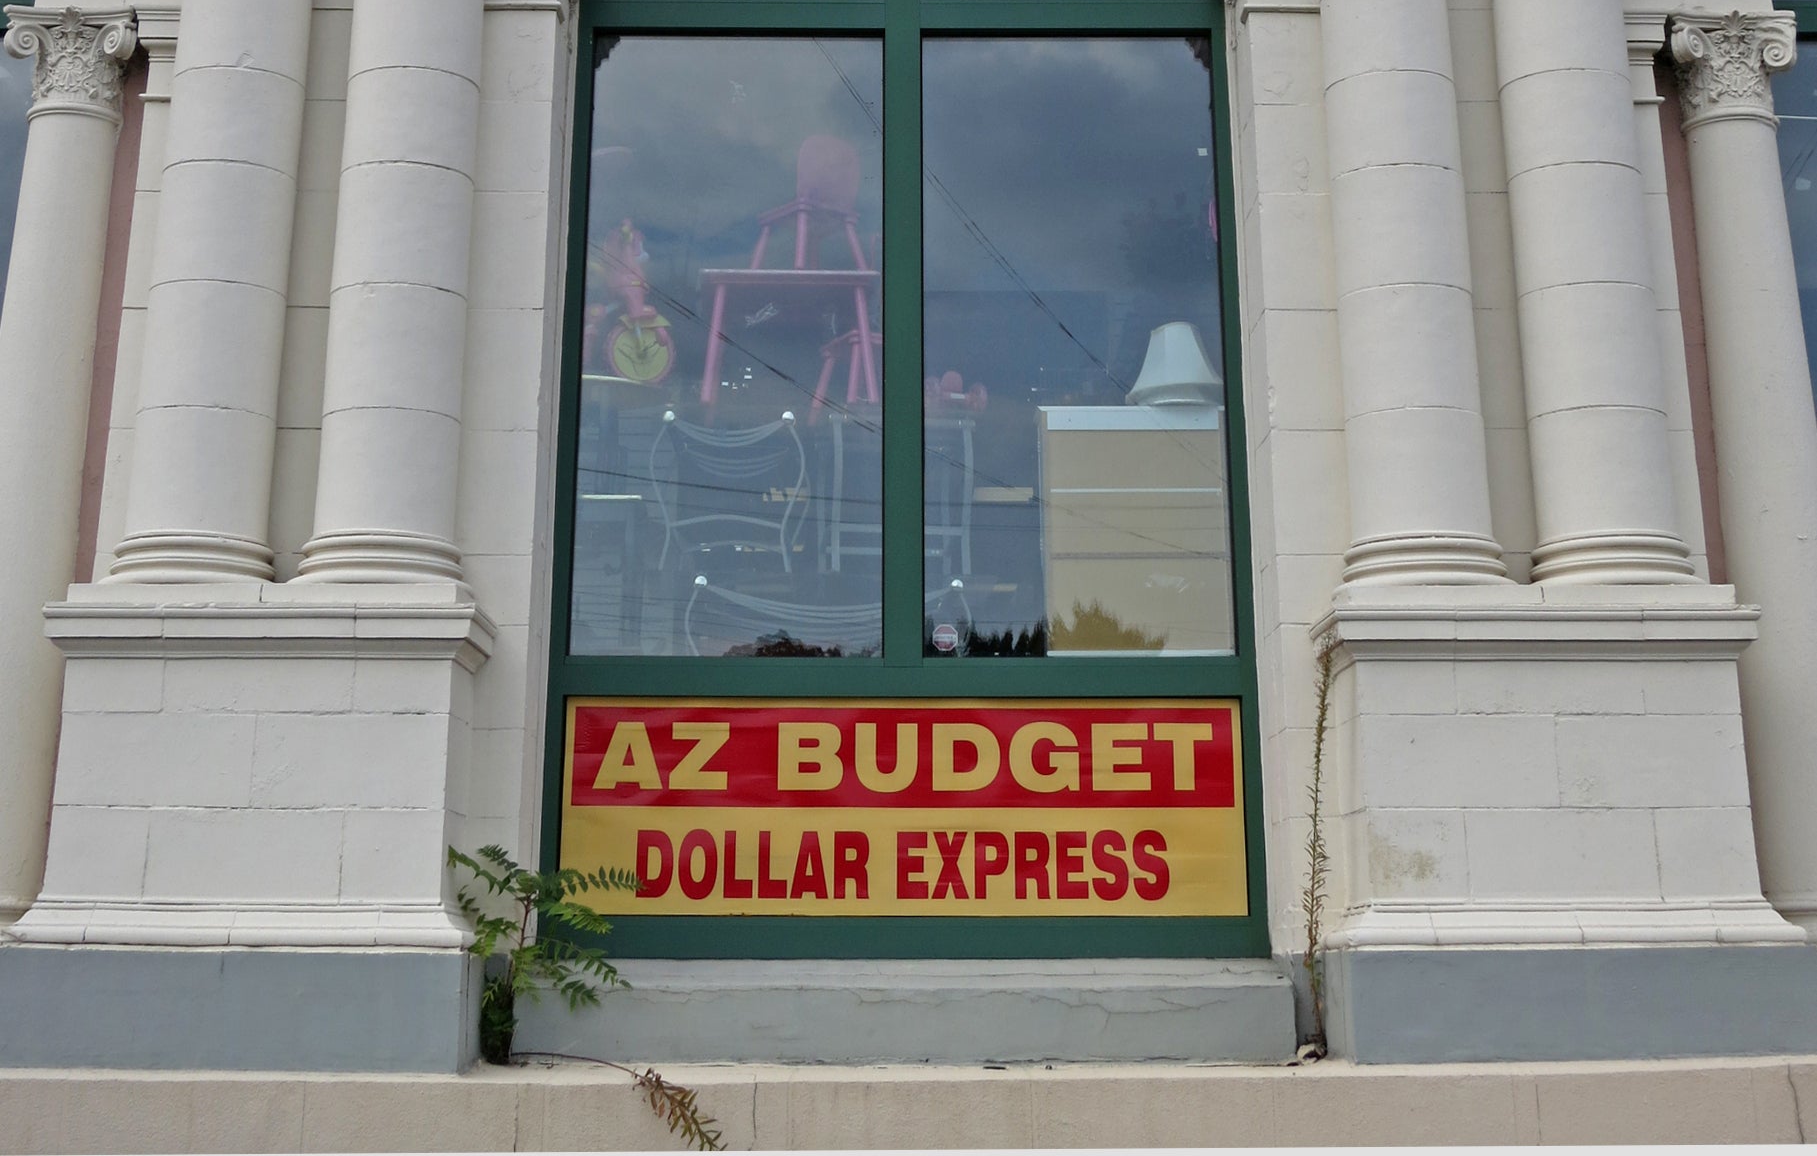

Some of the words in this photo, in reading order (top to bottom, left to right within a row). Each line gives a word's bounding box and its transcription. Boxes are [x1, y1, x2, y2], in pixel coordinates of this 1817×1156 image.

[592, 721, 731, 790] AZ
[777, 721, 1213, 793] BUDGET
[635, 828, 870, 900] DOLLAR
[896, 829, 1171, 902] EXPRESS
